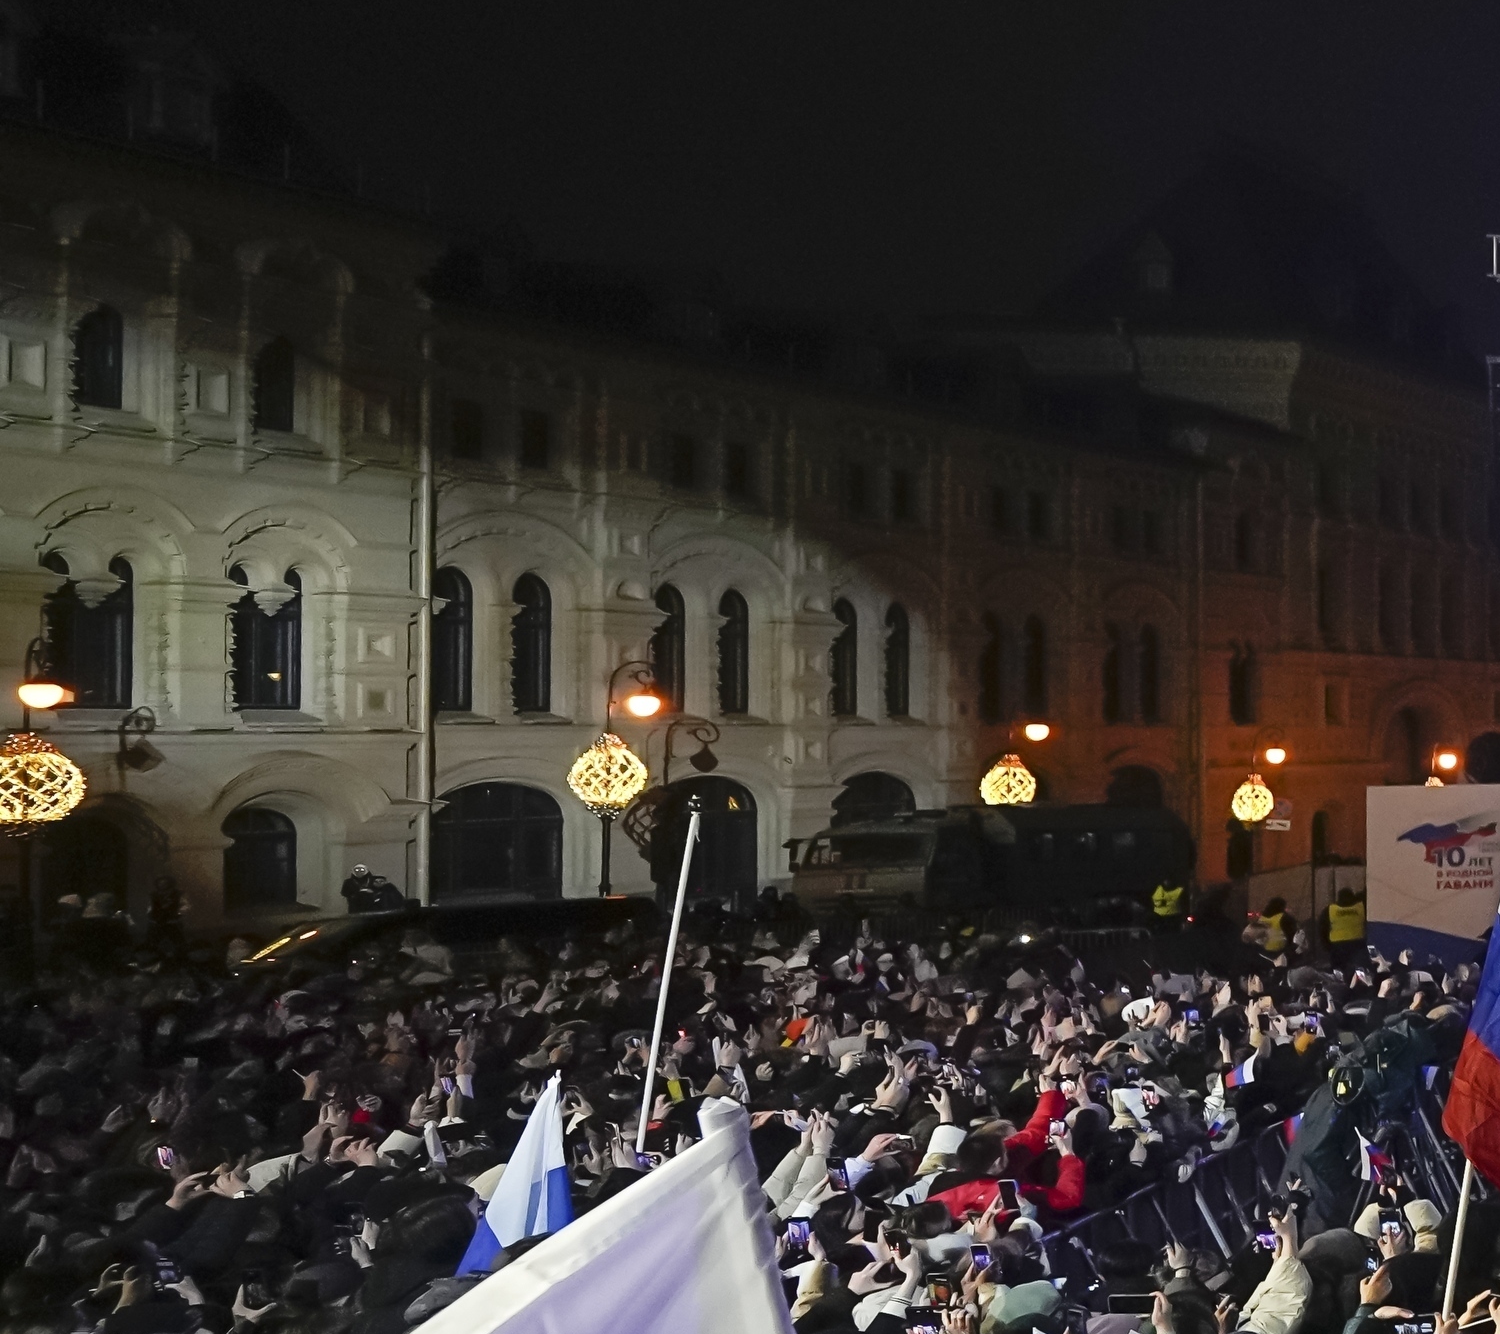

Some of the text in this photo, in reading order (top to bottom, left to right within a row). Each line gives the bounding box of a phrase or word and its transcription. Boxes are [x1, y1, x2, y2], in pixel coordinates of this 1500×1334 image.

[1432, 846, 1465, 868] 10
[1469, 856, 1493, 866] ЛЕТ
[1436, 879, 1494, 890] ГАВАНИ
